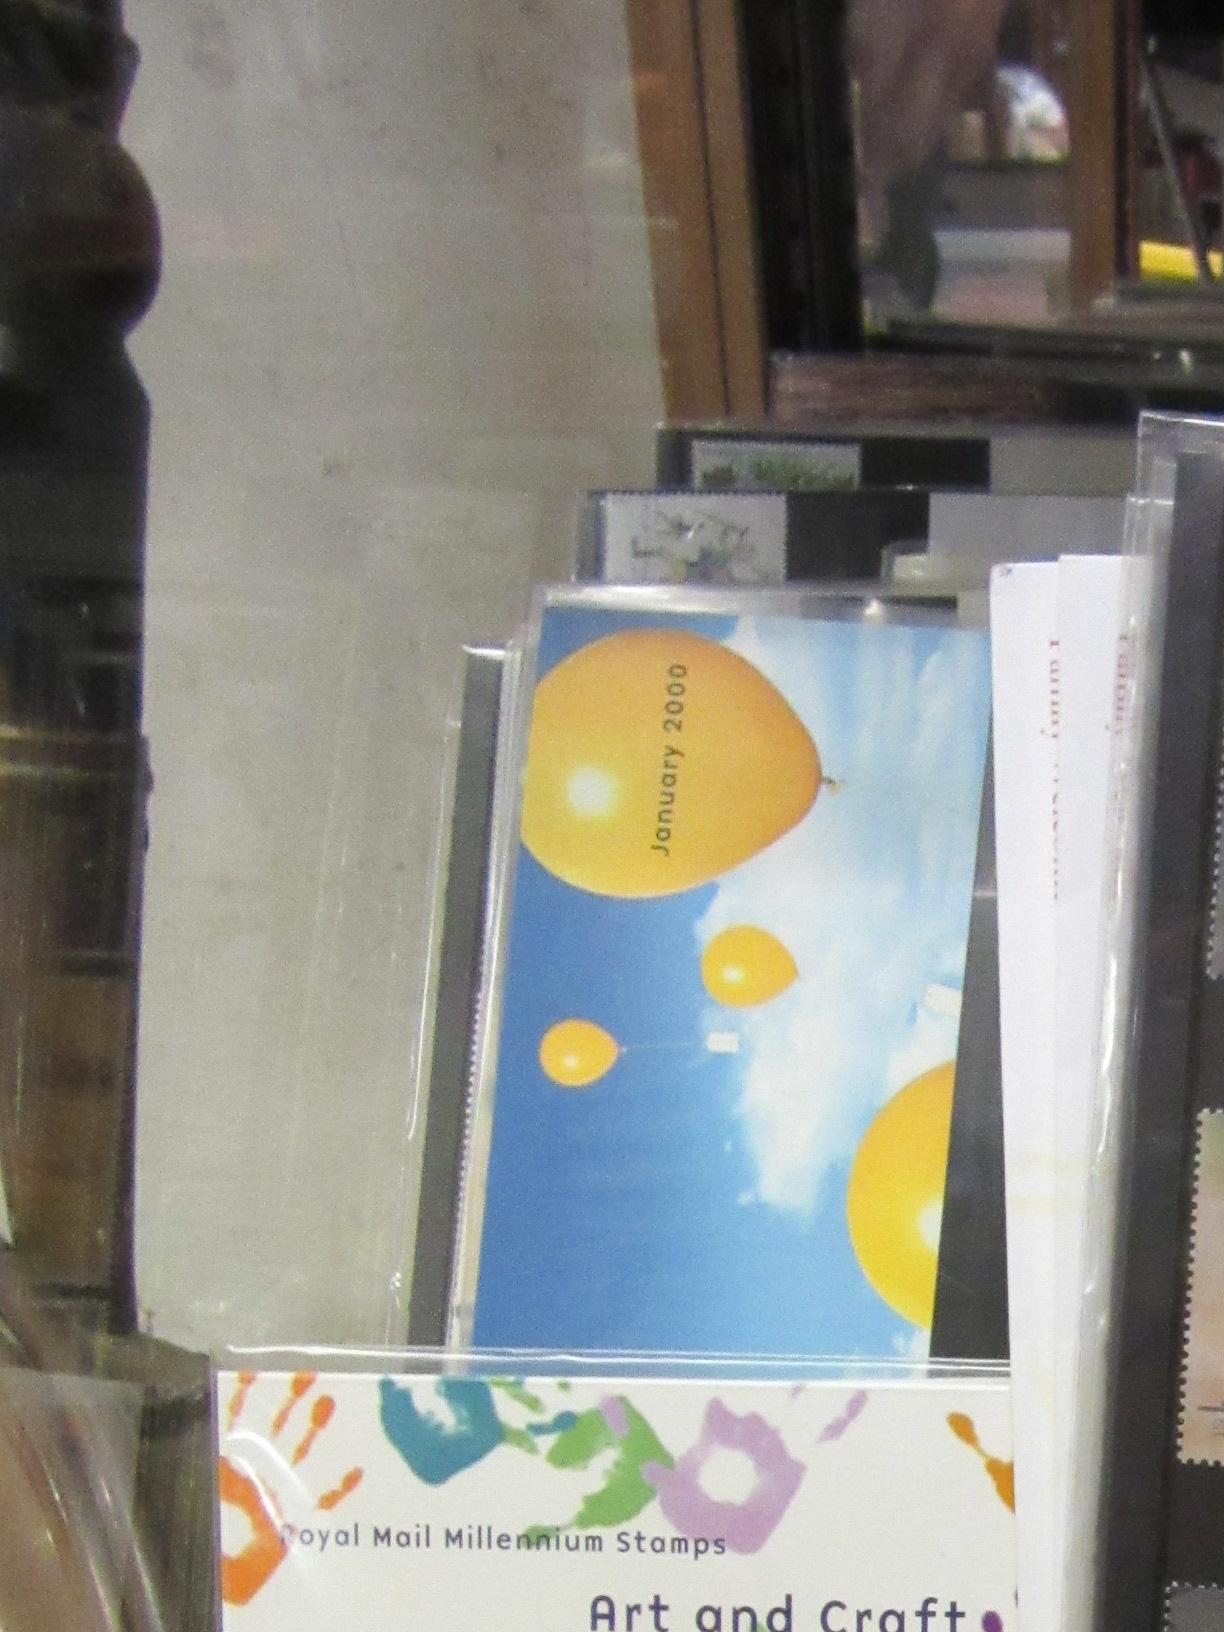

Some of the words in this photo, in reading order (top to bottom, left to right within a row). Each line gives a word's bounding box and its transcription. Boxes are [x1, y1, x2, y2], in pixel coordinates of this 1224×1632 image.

[663, 663, 688, 734] 2000
[651, 744, 686, 857] January
[373, 1524, 431, 1550] Mail
[444, 1525, 603, 1553] Millennium
[617, 1530, 727, 1560] Stamps
